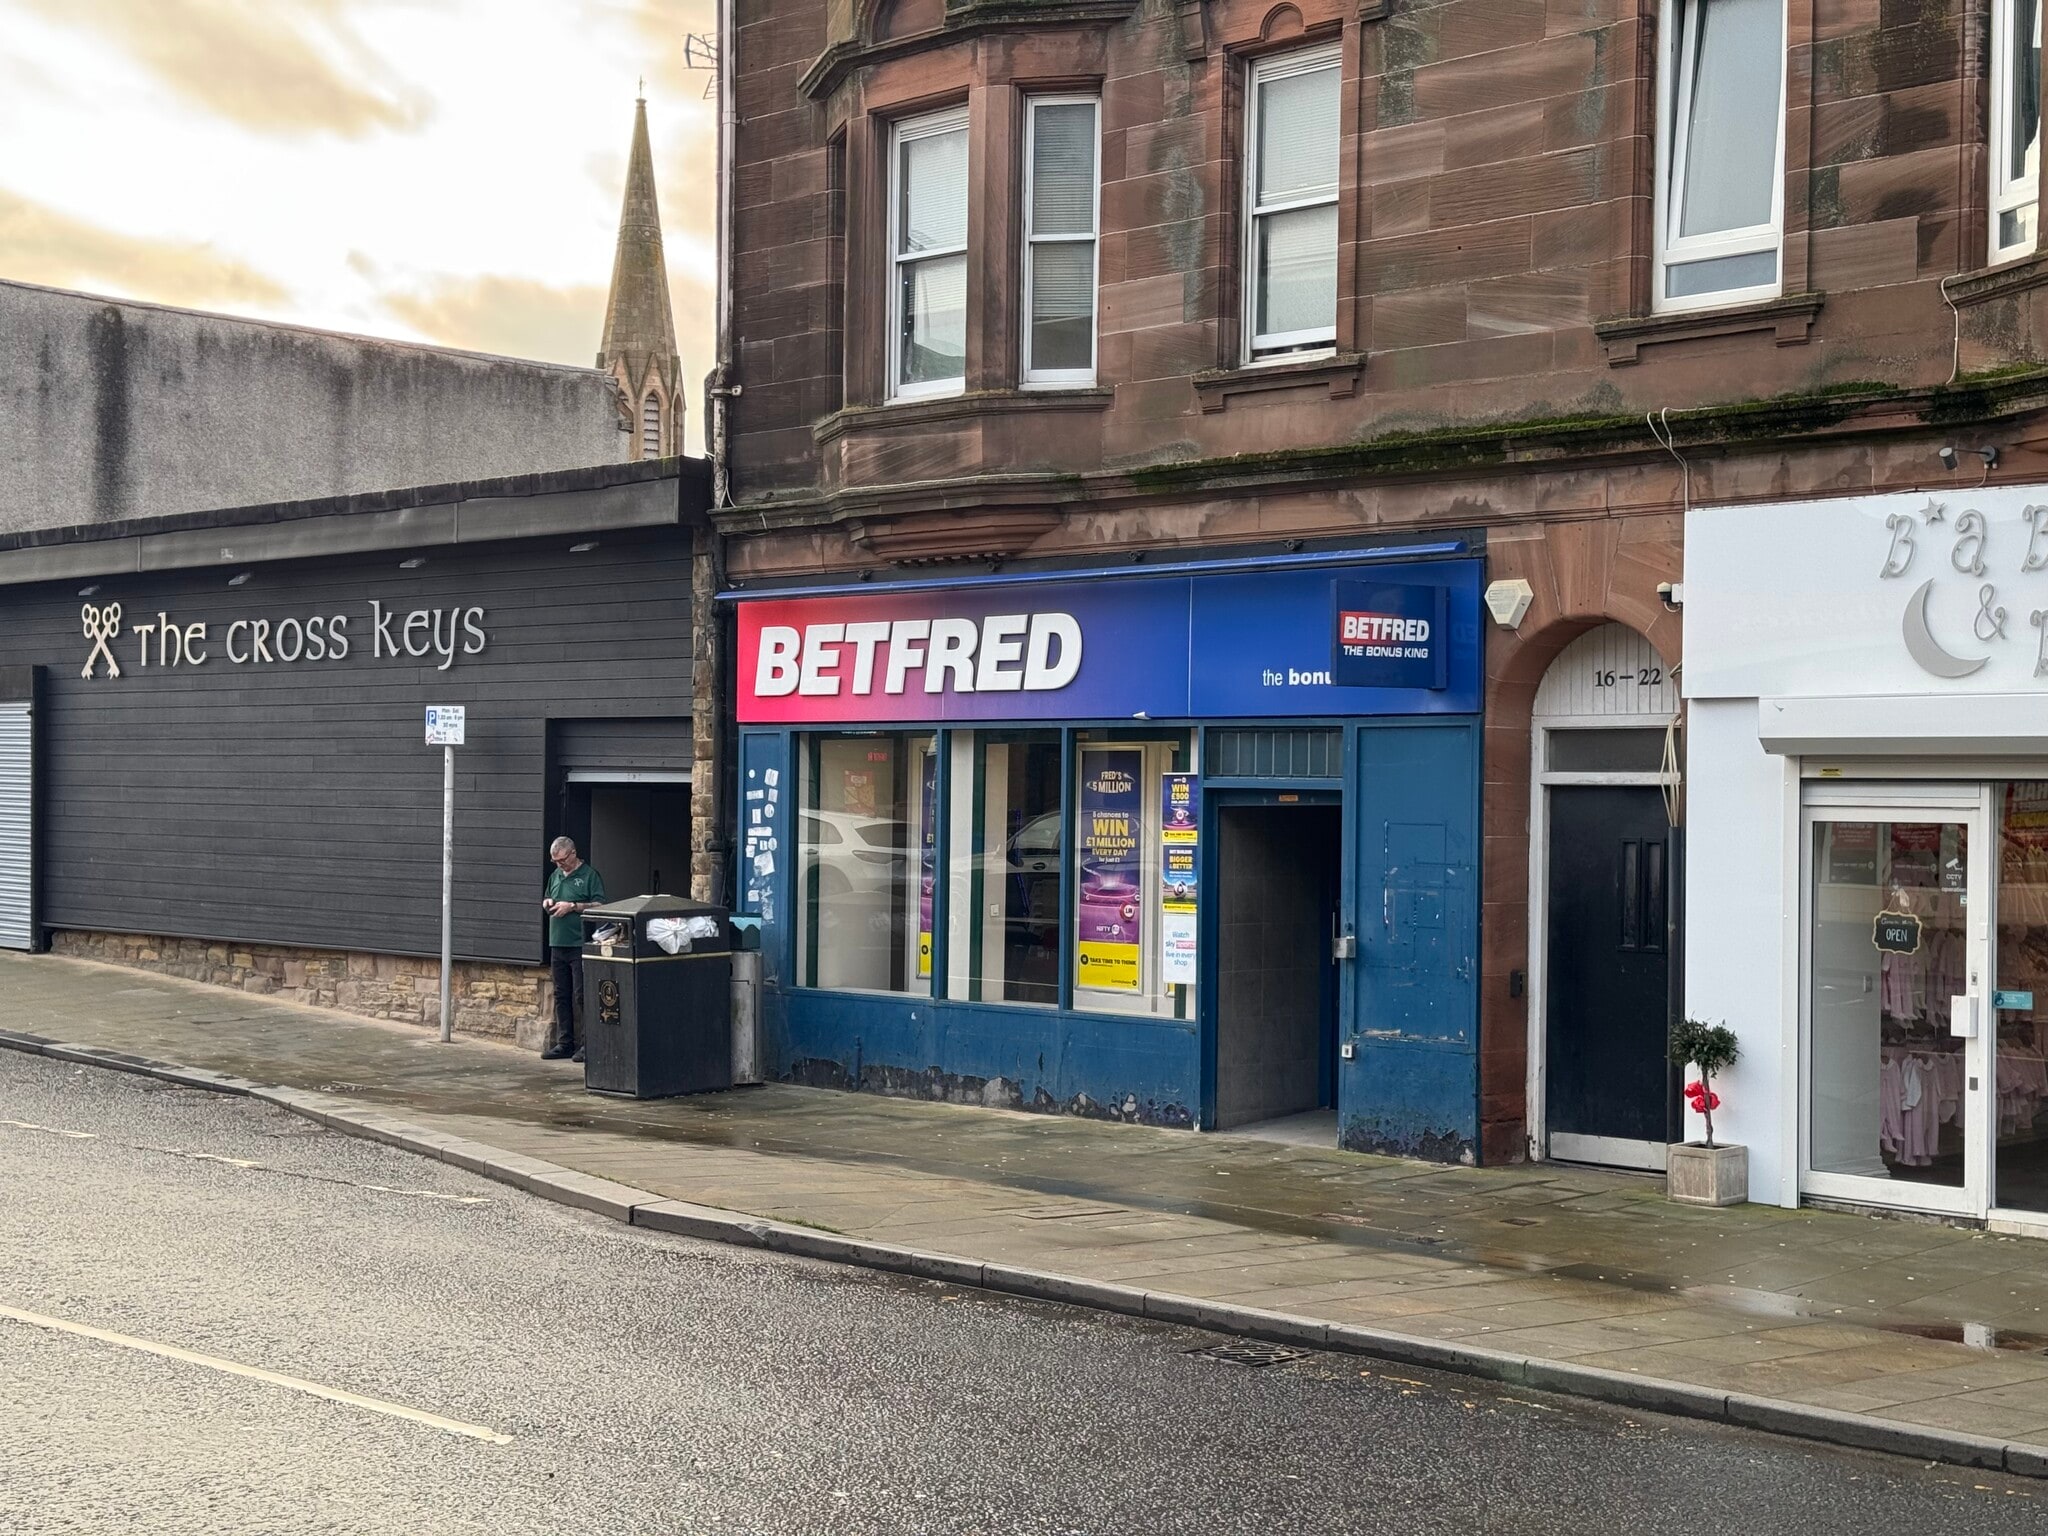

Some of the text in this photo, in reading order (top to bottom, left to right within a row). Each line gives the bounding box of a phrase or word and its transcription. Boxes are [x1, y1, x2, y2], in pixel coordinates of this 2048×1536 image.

[1343, 616, 1430, 642] BETFRED
[754, 612, 1084, 697] BETFRED
[1343, 645, 1429, 658] THE BONUS KING
[1263, 668, 1332, 686] the bonu
[1098, 781, 1132, 793] MILLION
[1171, 783, 1190, 793] WIN
[1093, 819, 1129, 836] WIN
[1097, 837, 1135, 848] MILLION
[1886, 928, 1908, 942] OPEN
